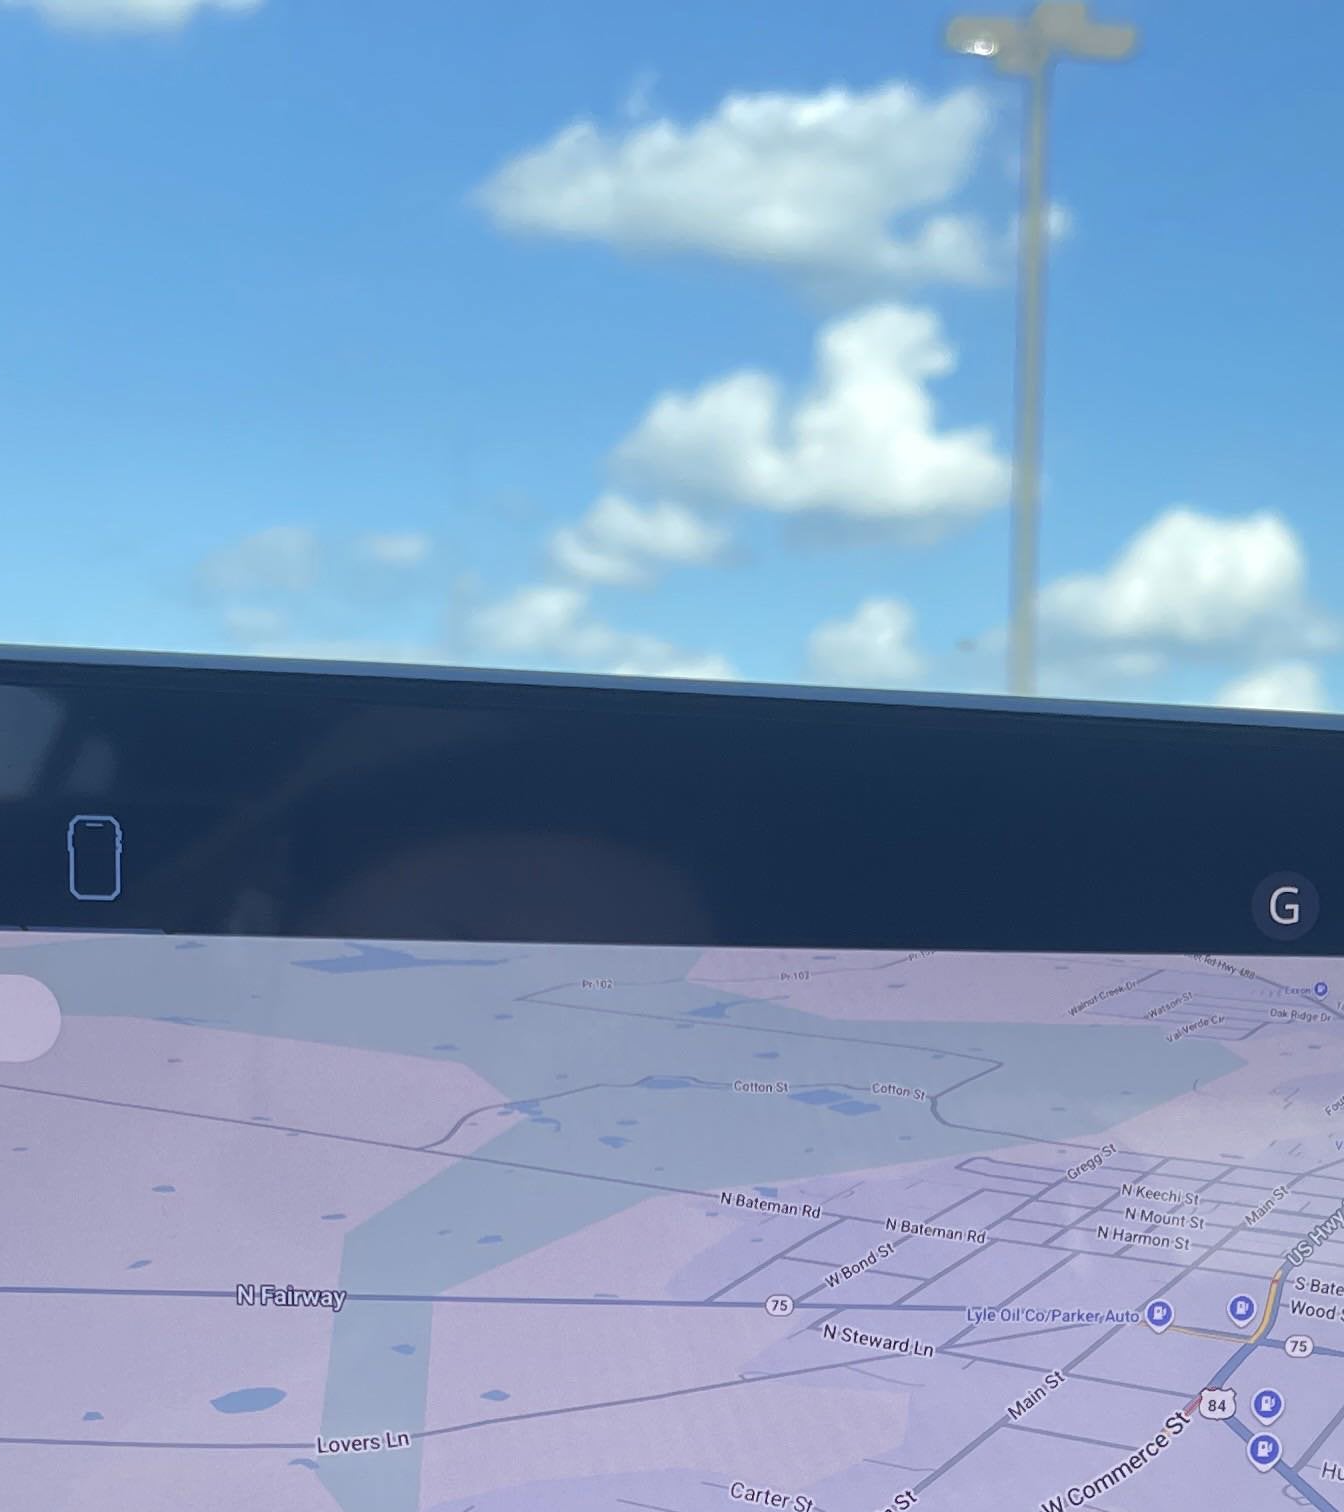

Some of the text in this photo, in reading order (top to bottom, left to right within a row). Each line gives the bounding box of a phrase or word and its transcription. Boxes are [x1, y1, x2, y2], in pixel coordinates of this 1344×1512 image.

[1269, 886, 1299, 925] G
[1068, 980, 1137, 1017] Walnut Creek Dr
[1270, 1007, 1331, 1023] Oak Ridge Dr
[733, 1080, 790, 1093] Cotton St
[1066, 1143, 1117, 1181] Gregg St
[720, 1192, 821, 1219] N Bateman Rd
[1121, 1183, 1199, 1206] N Keechi St
[1244, 1184, 1289, 1226] Main St
[885, 1218, 986, 1244] N Bateman Rd
[1124, 1207, 1204, 1230] N Mount St
[1097, 1225, 1190, 1251] N Harmon St
[824, 1242, 896, 1289] W Bond St
[1286, 1240, 1313, 1267] US
[1294, 1276, 1306, 1291] S
[236, 1284, 347, 1312] N Fairway
[771, 1300, 788, 1312] 75
[1290, 1300, 1336, 1321] Wood
[967, 1308, 1140, 1324] Lyle Oil Co/Parker Auto
[823, 1325, 934, 1358] N Steward Ln
[1289, 1340, 1308, 1353] 75
[1007, 1370, 1066, 1422] Main St
[1208, 1400, 1226, 1413] 84
[316, 1431, 410, 1454] Lovers Ln
[1068, 1432, 1171, 1509] Commerce
[1164, 1410, 1191, 1436] St
[730, 1482, 787, 1511] Carter
[894, 1490, 918, 1512] St
